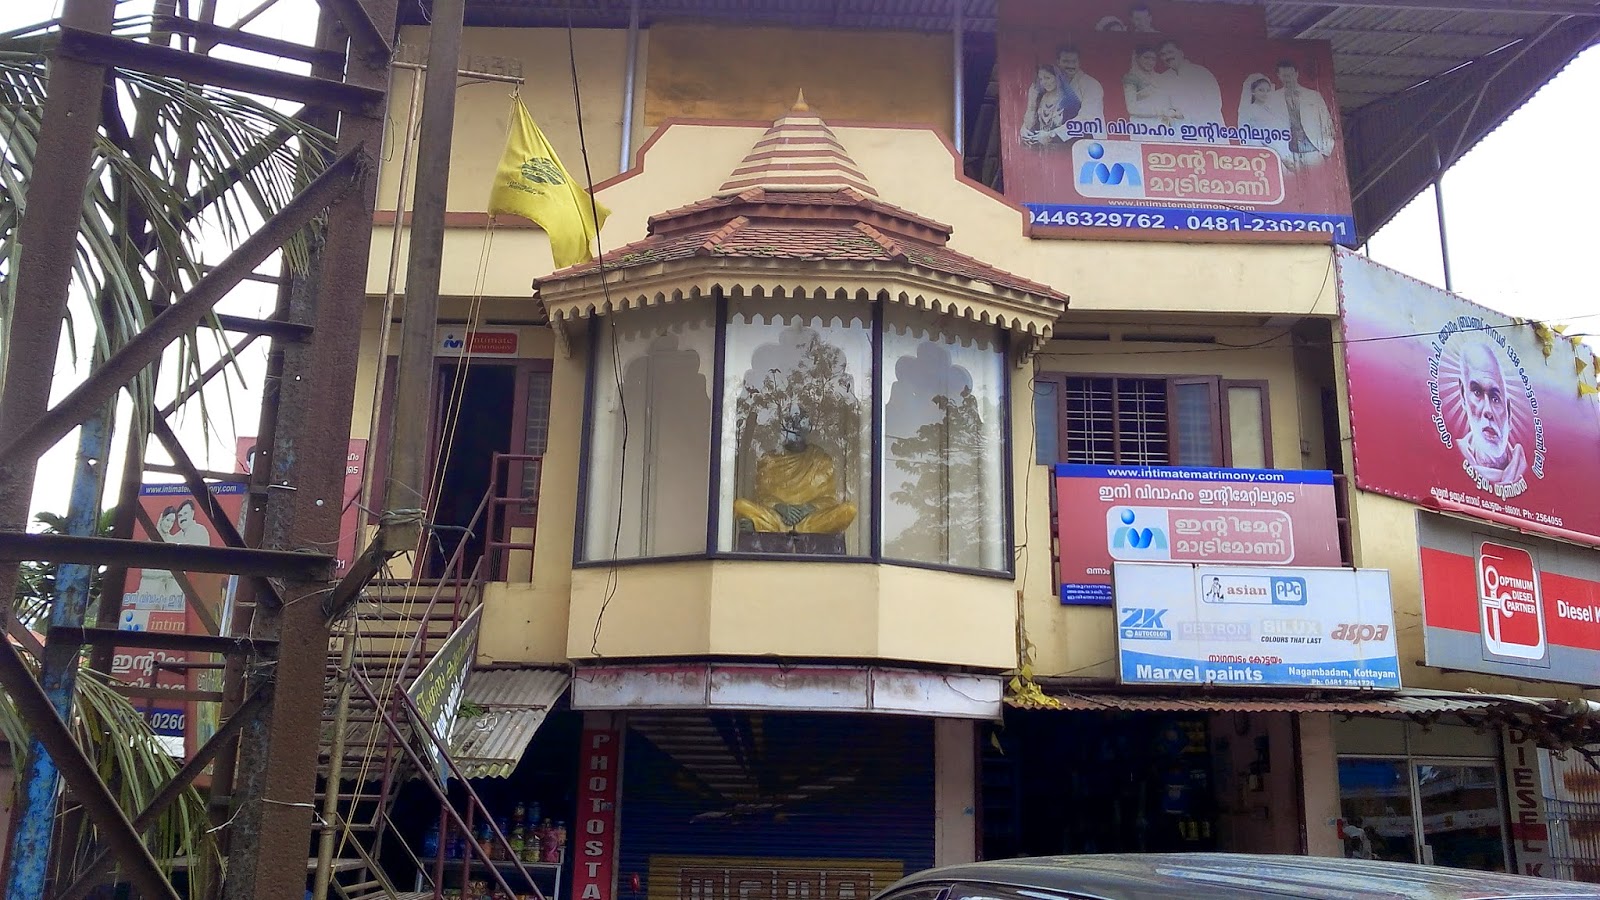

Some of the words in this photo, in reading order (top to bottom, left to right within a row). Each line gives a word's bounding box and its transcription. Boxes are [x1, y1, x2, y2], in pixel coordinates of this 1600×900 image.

[1066, 118, 1102, 138] ഇനി
[1107, 119, 1175, 138] വിവാഹം
[1149, 175, 1271, 197] മാട്രിമോണി
[1108, 199, 1255, 212] www.intimatematrimony.com
[1187, 216, 1347, 235] 0481-2302601
[1506, 345, 1521, 368] 1338
[1107, 468, 1285, 482] www.intimatematrimony.com
[1099, 483, 1131, 501] ഇനി
[1135, 483, 1194, 501] വിവാഹം
[1535, 512, 1563, 526] 2564055
[1176, 537, 1286, 557] മാട്രിമോണി
[1227, 584, 1267, 596] asian
[1277, 581, 1301, 597] PPG
[1500, 575, 1533, 591] OPTIMUM
[1512, 590, 1535, 603] DIESEL
[1507, 601, 1536, 614] PARTNER
[1557, 599, 1593, 622] Diesel
[1134, 630, 1168, 638] AUTOCOLOR
[1331, 623, 1390, 645] aspa
[1136, 664, 1199, 680] Marvel
[1205, 666, 1263, 683] paints
[1288, 666, 1352, 678] Nagambadam,
[1354, 668, 1396, 680] Kottayam
[582, 734, 611, 899] PHOTOSTA
